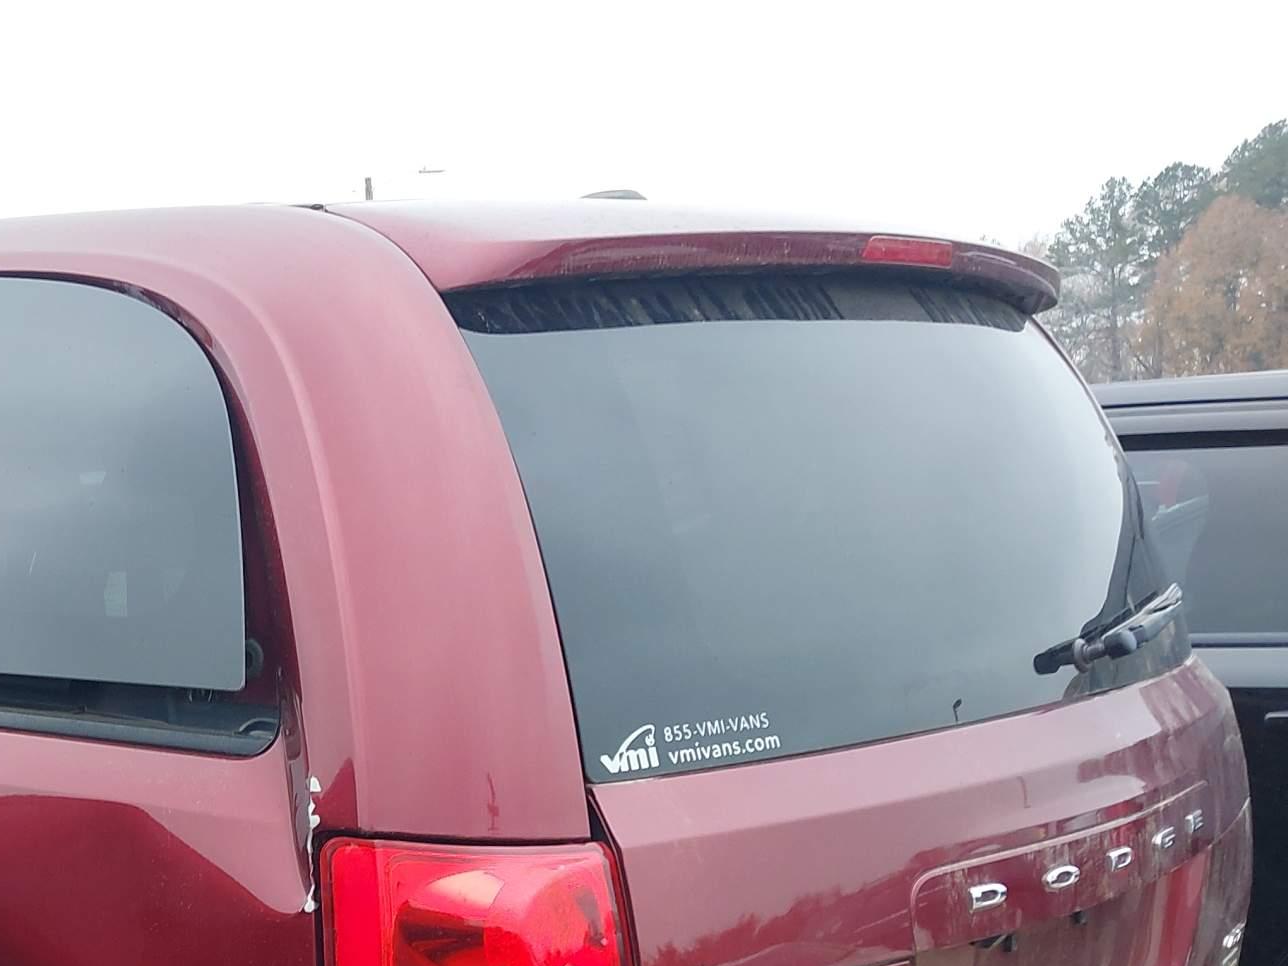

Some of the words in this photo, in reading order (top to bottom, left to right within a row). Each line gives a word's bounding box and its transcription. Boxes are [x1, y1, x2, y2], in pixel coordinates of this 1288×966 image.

[663, 712, 770, 743] 855-VMI-VANS
[668, 734, 781, 765] vmivans.com
[968, 809, 1204, 912] DODGE
